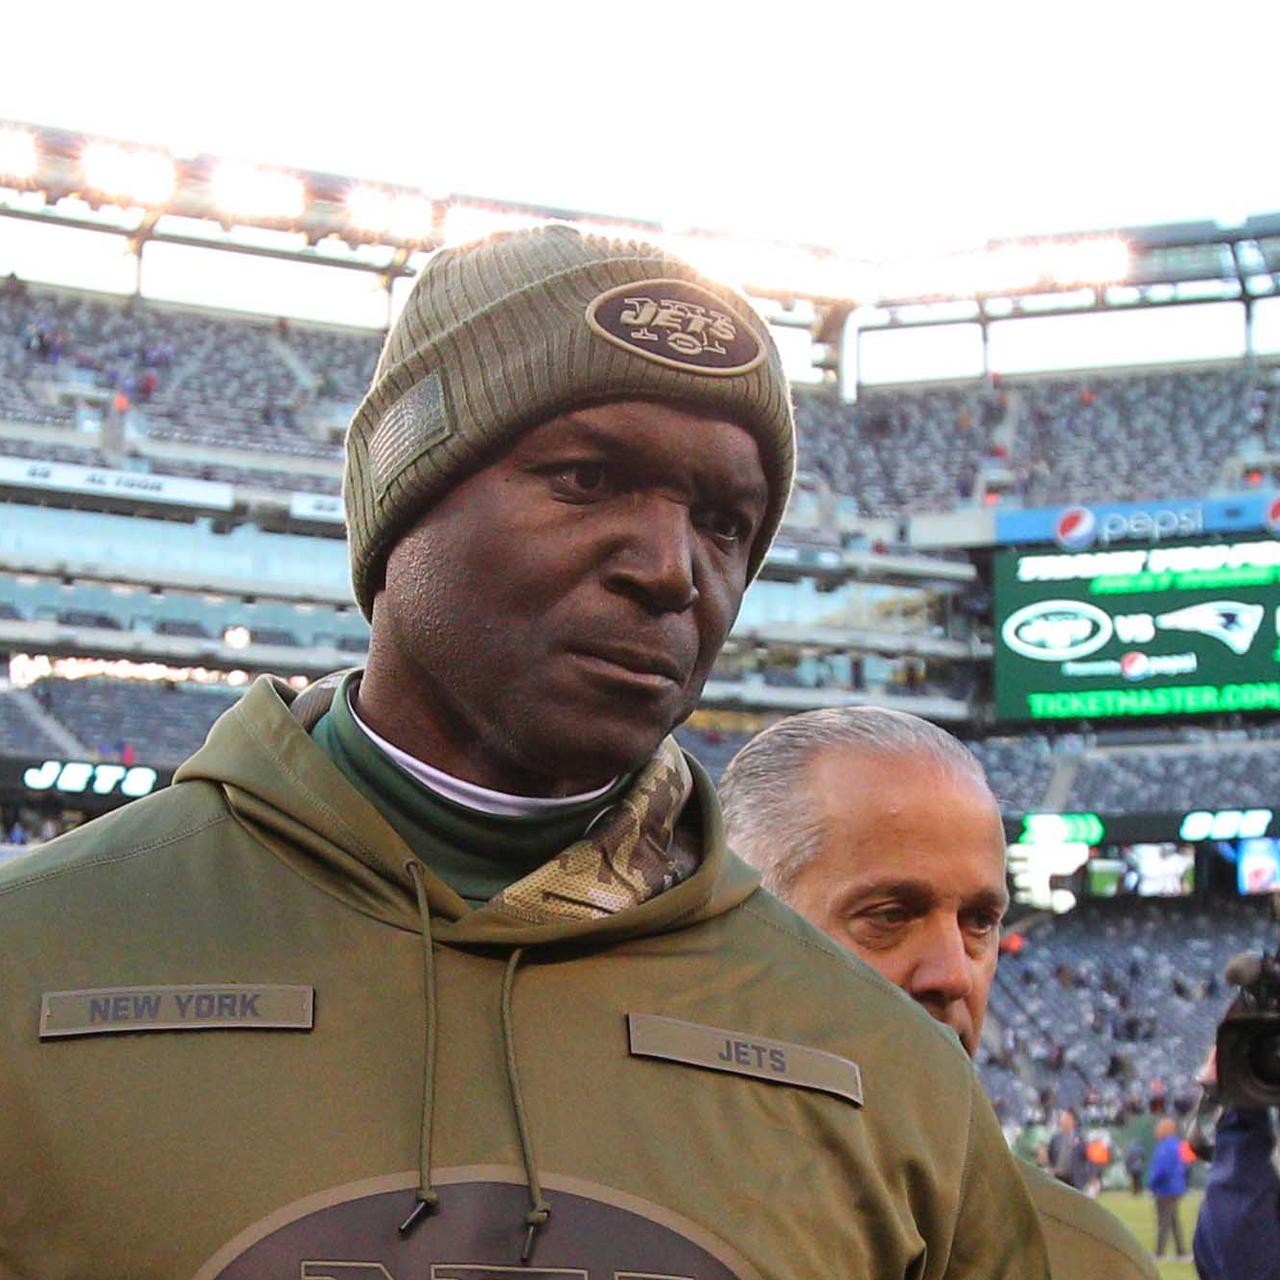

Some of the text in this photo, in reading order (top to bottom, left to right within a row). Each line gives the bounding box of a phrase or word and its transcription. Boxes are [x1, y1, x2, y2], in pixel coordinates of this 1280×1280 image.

[621, 302, 737, 341] JETS
[1100, 507, 1204, 546] pepsi
[24, 761, 157, 797] JETS
[1180, 809, 1272, 840] SEE
[88, 992, 262, 1023] NEW YORK
[718, 1039, 787, 1073] JETS
